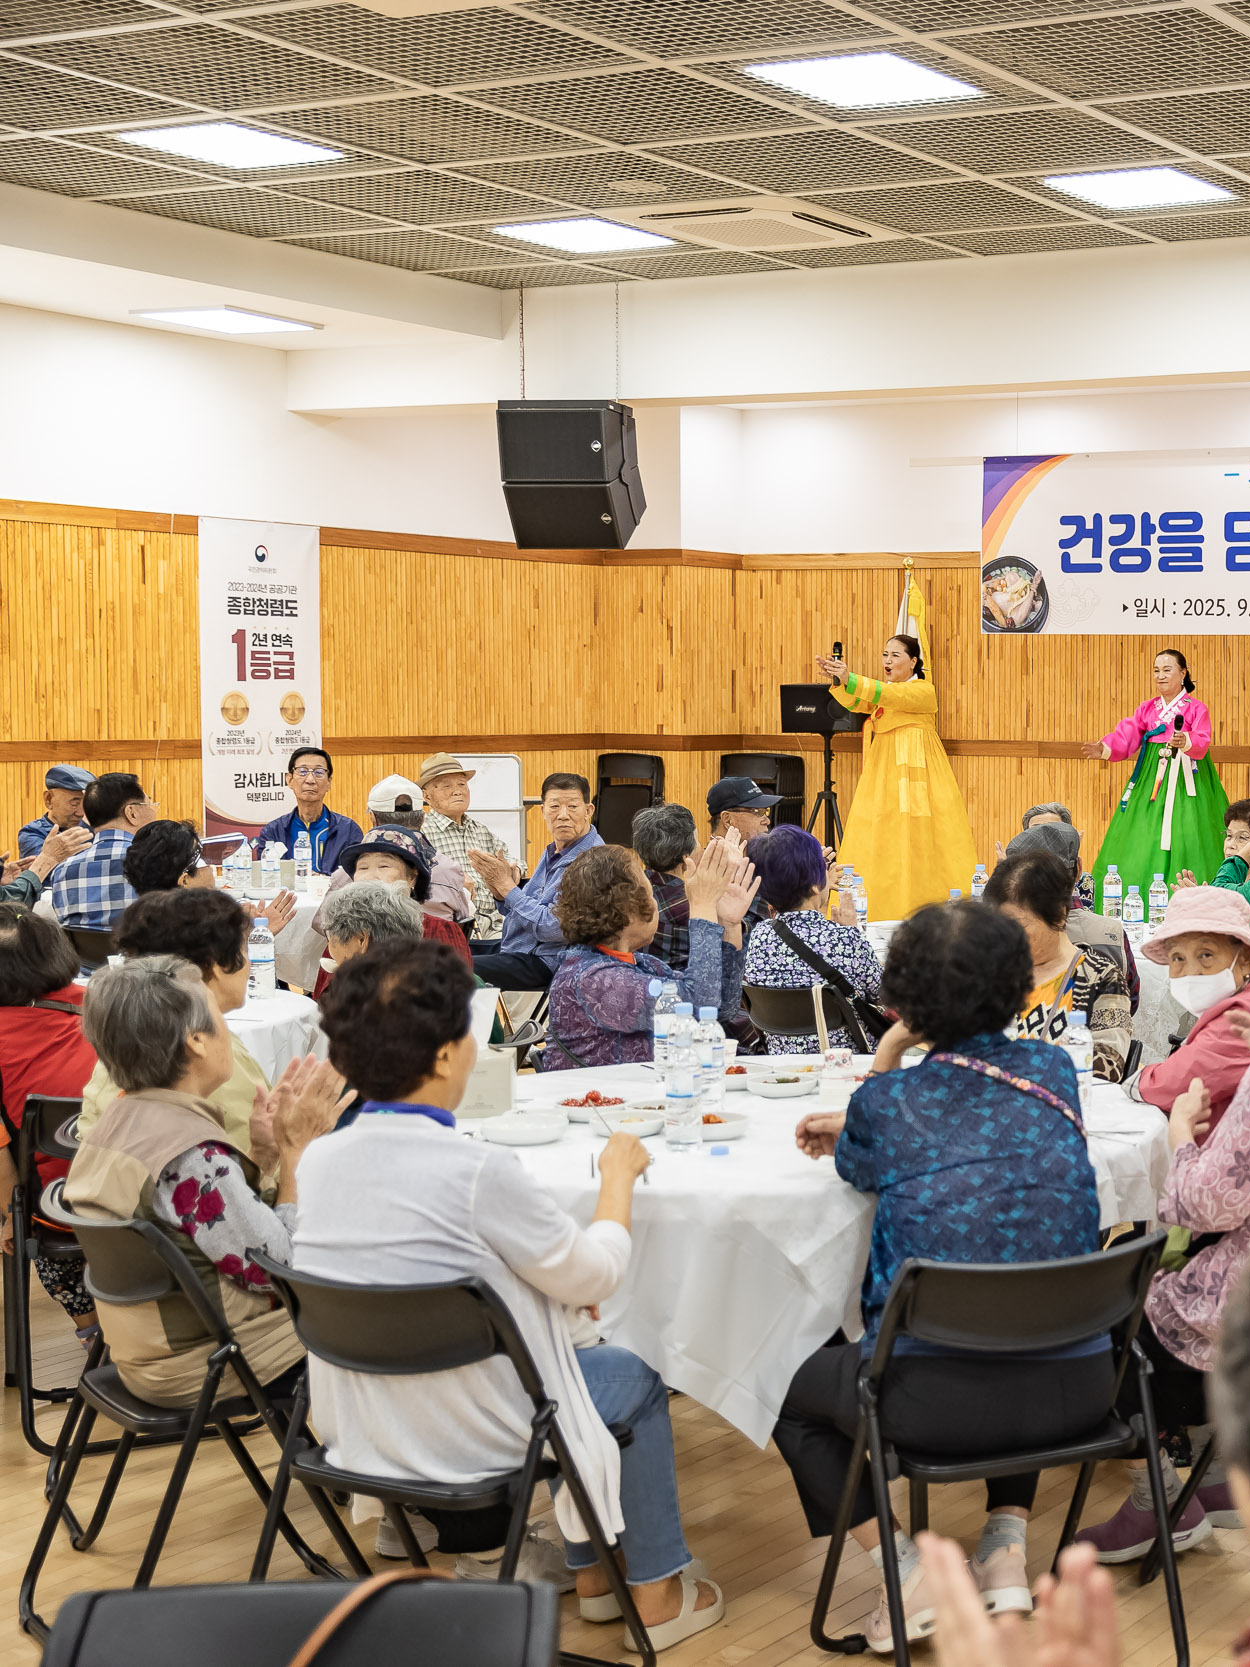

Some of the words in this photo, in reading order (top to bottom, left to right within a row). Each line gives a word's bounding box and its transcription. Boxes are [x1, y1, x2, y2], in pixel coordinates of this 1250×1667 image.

[1058, 511, 1205, 573] 건강을
[268, 584, 298, 595] 공공기관
[227, 596, 298, 617] 종합청렴도
[1133, 597, 1165, 618] 일시
[1182, 598, 1231, 617] 2025.
[252, 633, 268, 648] 2년
[271, 633, 293, 648] 연속
[246, 792, 285, 802] 덕분입니다
